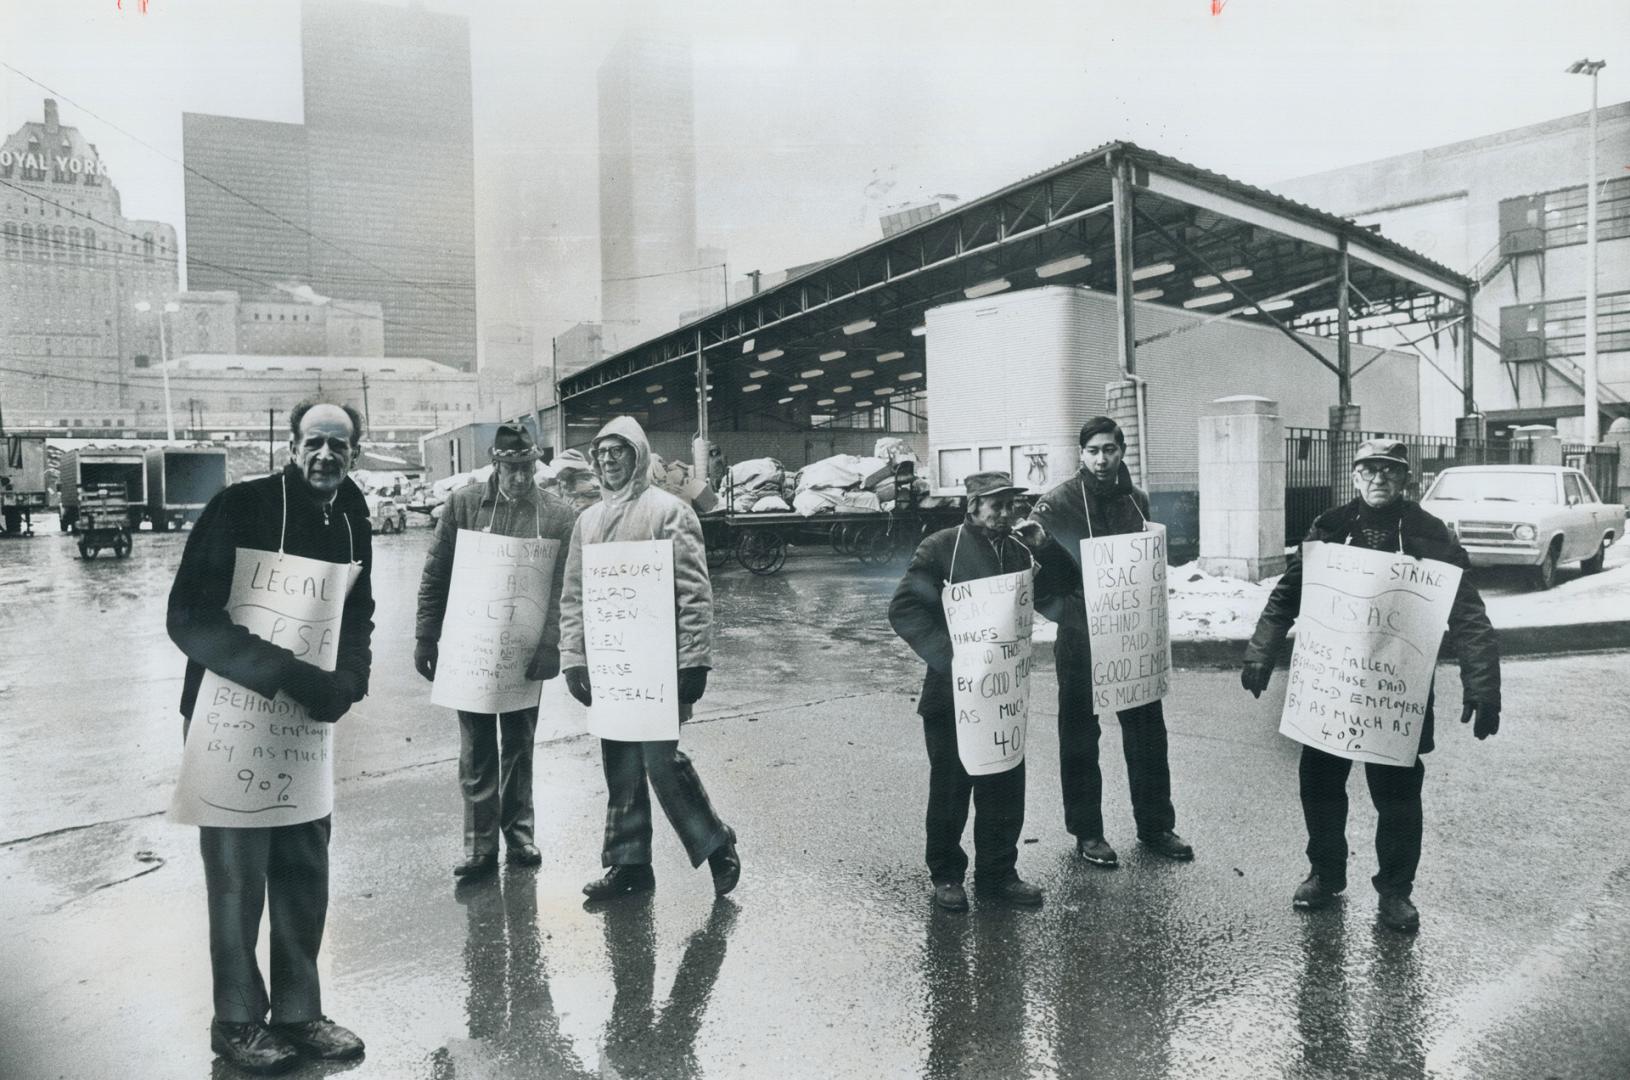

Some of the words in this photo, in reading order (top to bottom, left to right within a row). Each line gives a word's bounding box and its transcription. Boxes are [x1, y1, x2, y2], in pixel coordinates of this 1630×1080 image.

[56, 155, 110, 176] YORK
[1093, 543, 1114, 566] ON
[251, 562, 331, 602] LEGAL
[1097, 565, 1138, 589] PSAC
[1390, 562, 1446, 588] STRIKE
[951, 583, 973, 602] ON
[1087, 588, 1141, 614] WAGES
[1090, 612, 1140, 637] BEHIND
[1331, 595, 1402, 632] PSAC
[1121, 632, 1150, 653] PAID
[1298, 630, 1333, 660] WAGES
[957, 676, 973, 693] BY
[981, 671, 1010, 699] GOOD
[1093, 658, 1132, 686] GOOD
[1329, 666, 1368, 688] THOSE
[1378, 679, 1407, 695] PAID
[1093, 689, 1110, 709] AS
[1115, 682, 1151, 706] MUCH
[1351, 693, 1425, 718] EMPLOYERS
[958, 709, 981, 724] AS
[1310, 700, 1326, 717] AS
[1334, 709, 1383, 730] MUCH
[1393, 719, 1412, 737] AS
[1321, 722, 1365, 752] 40%
[253, 746, 276, 760] AS
[237, 768, 293, 803] 90%
